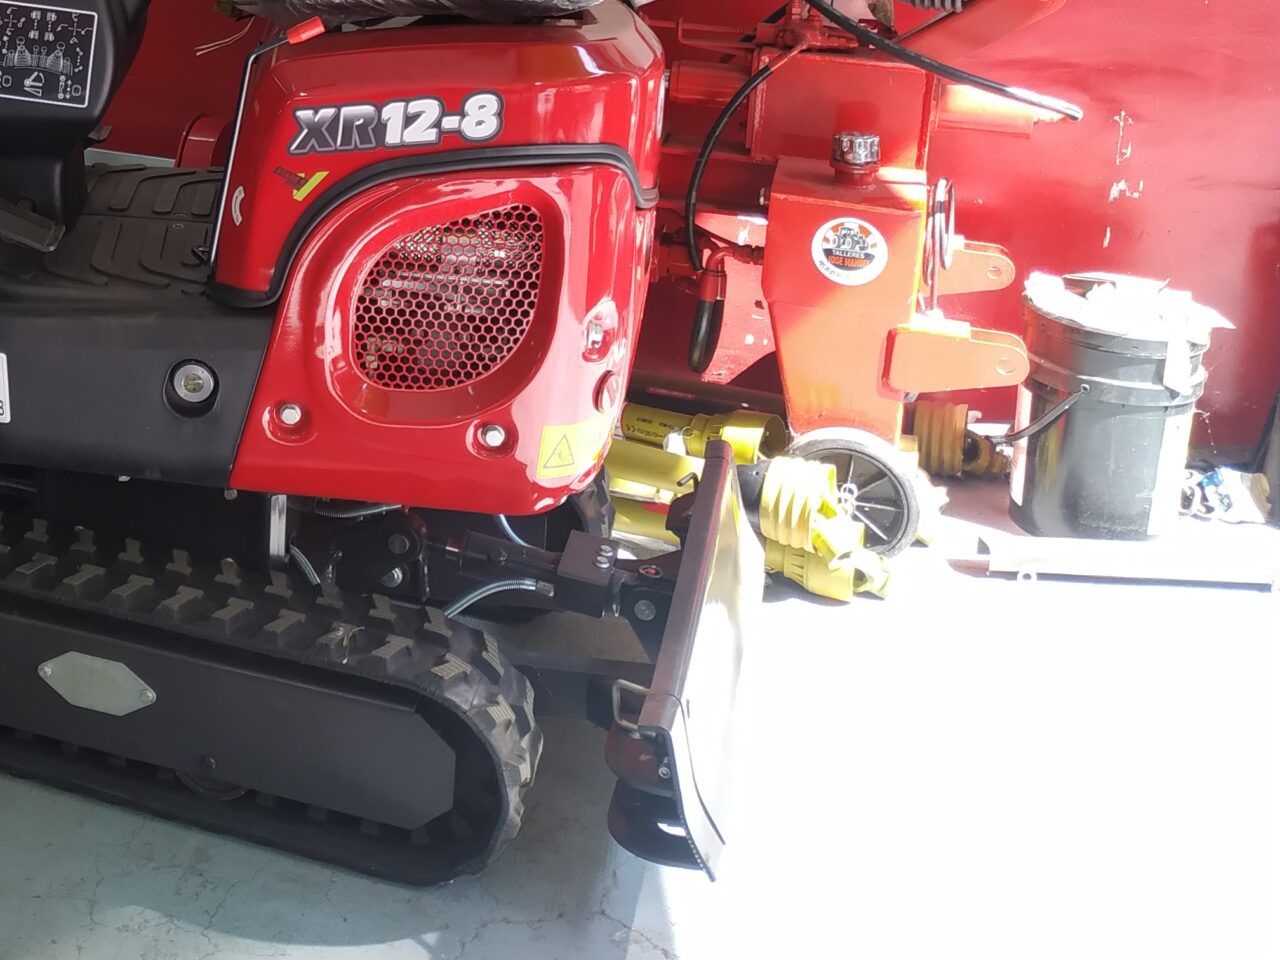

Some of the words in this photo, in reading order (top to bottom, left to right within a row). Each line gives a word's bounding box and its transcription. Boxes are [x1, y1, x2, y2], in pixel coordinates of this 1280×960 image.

[289, 92, 502, 154] XR12-8
[831, 249, 866, 259] TALLERES
[827, 255, 845, 265] JOSE
